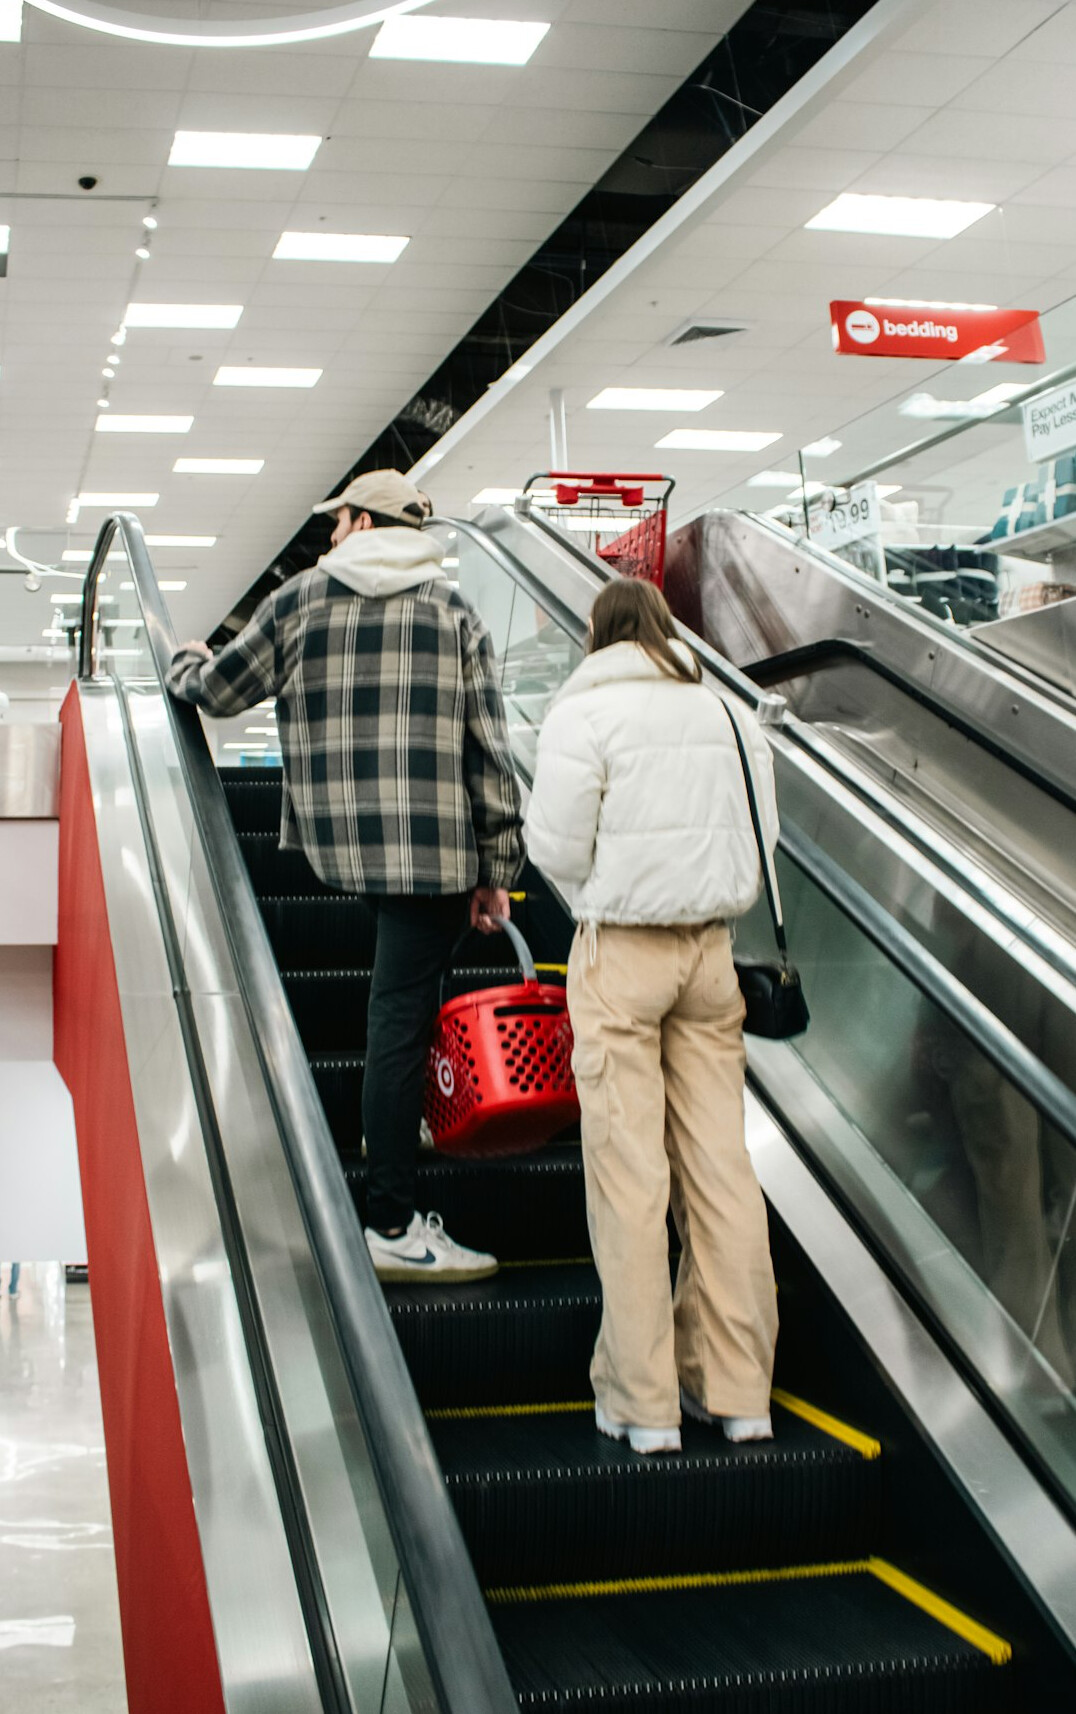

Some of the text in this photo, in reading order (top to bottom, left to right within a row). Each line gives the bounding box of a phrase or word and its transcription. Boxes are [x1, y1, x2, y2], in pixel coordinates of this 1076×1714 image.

[883, 319, 958, 343] bedding
[1031, 396, 1067, 423] Expect
[1032, 422, 1051, 438] Pay
